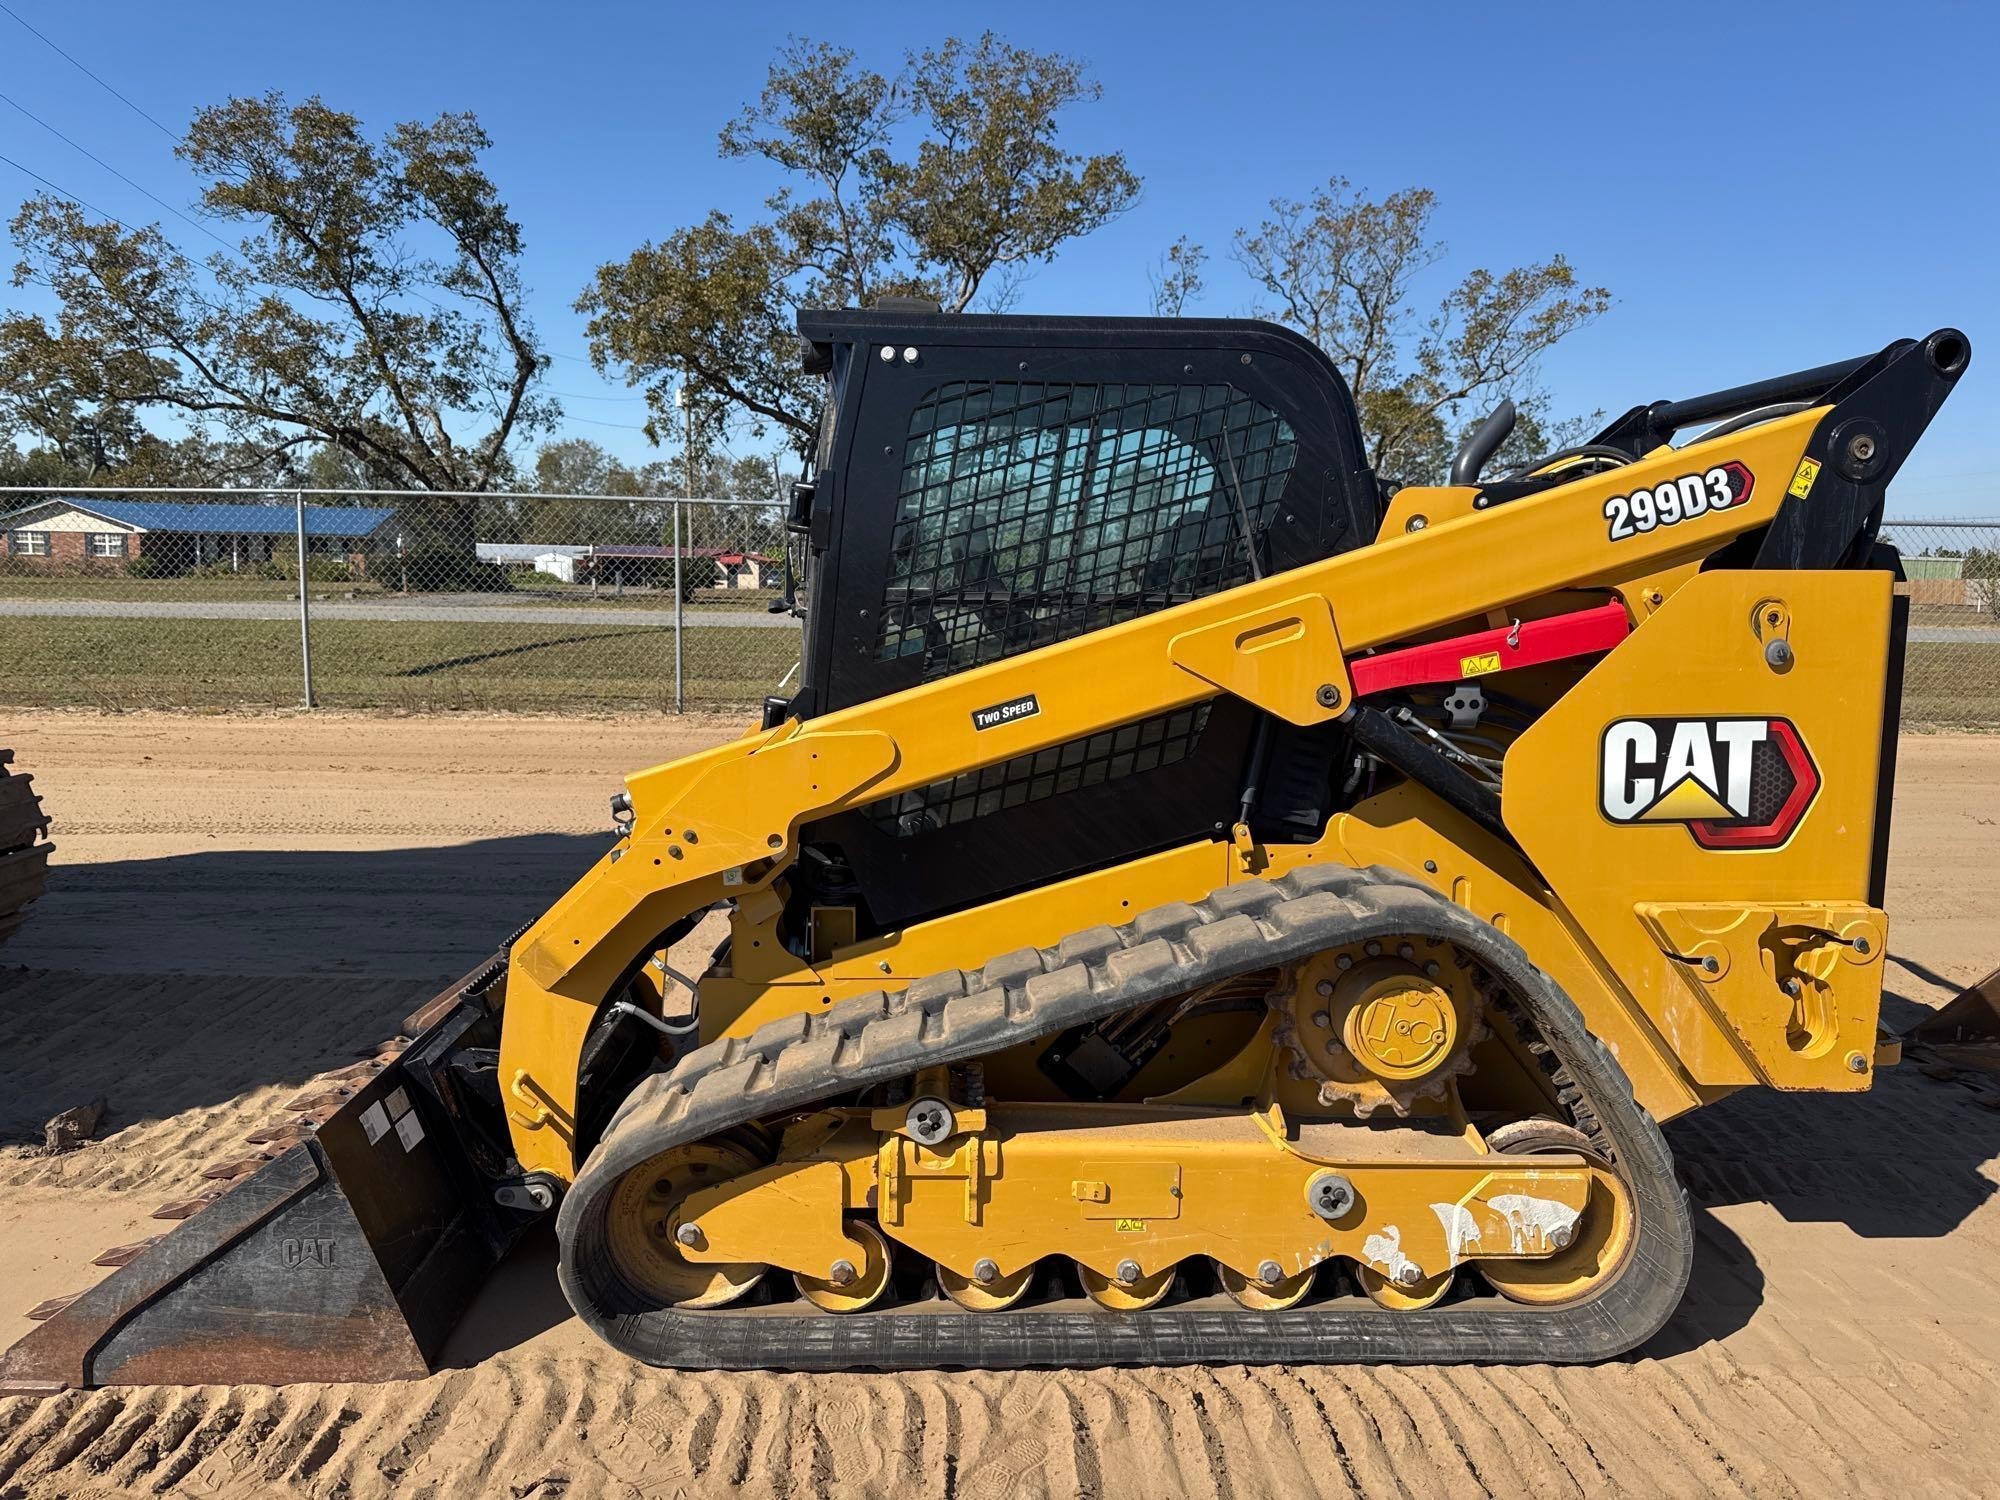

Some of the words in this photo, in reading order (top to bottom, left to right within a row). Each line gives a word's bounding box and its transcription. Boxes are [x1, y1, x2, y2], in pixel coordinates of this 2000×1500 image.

[1605, 467, 1733, 540] 299D3
[1603, 719, 1768, 820] CAT
[281, 1238, 336, 1270] CAT
